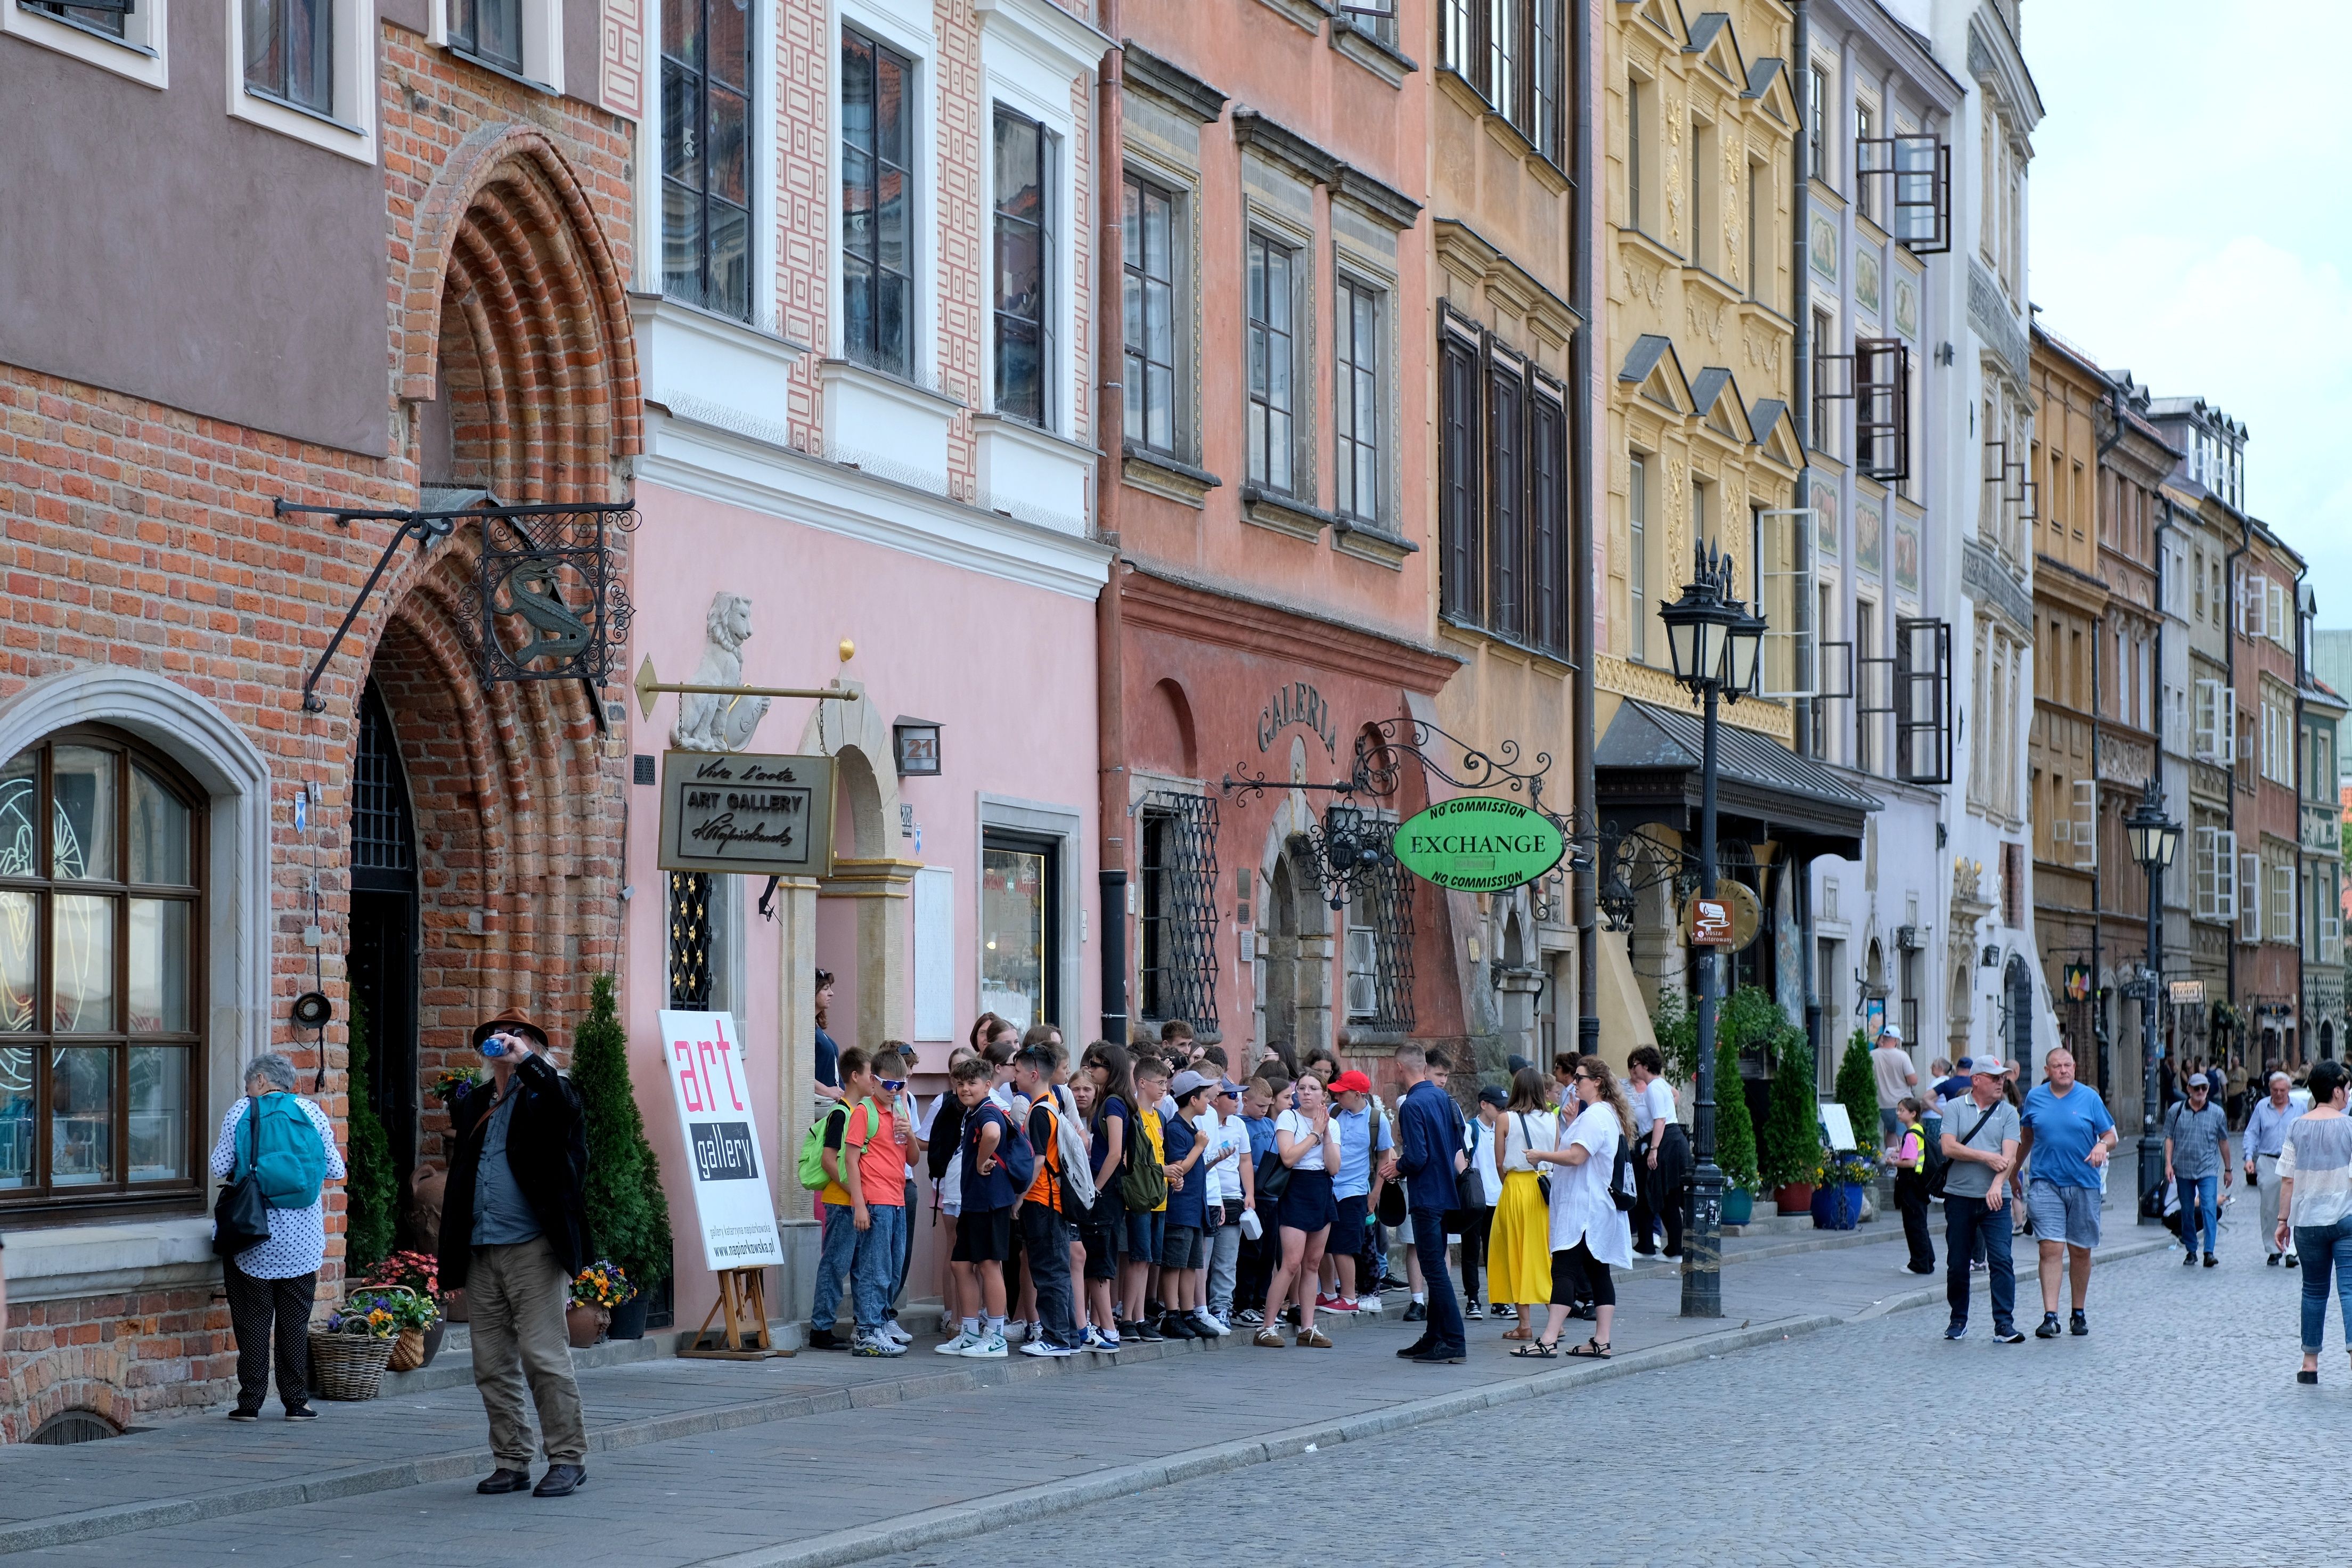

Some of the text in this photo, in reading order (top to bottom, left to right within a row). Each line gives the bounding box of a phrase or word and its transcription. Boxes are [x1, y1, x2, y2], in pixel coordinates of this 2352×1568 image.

[1258, 681, 1335, 764] GALERIA
[908, 740, 932, 757] 21
[697, 757, 732, 779] Viva
[688, 791, 803, 812] ART GALLERY
[1430, 801, 1527, 820] NO COMMISSION
[1410, 835, 1546, 853] EXCHANGE
[1431, 870, 1523, 888] NO COMMISSION
[674, 1019, 744, 1112] art
[697, 1124, 752, 1179] gallery
[710, 1224, 724, 1239] gallery
[723, 1224, 744, 1237] katarzyna
[713, 1237, 775, 1259] www.napiorkowska.pl
